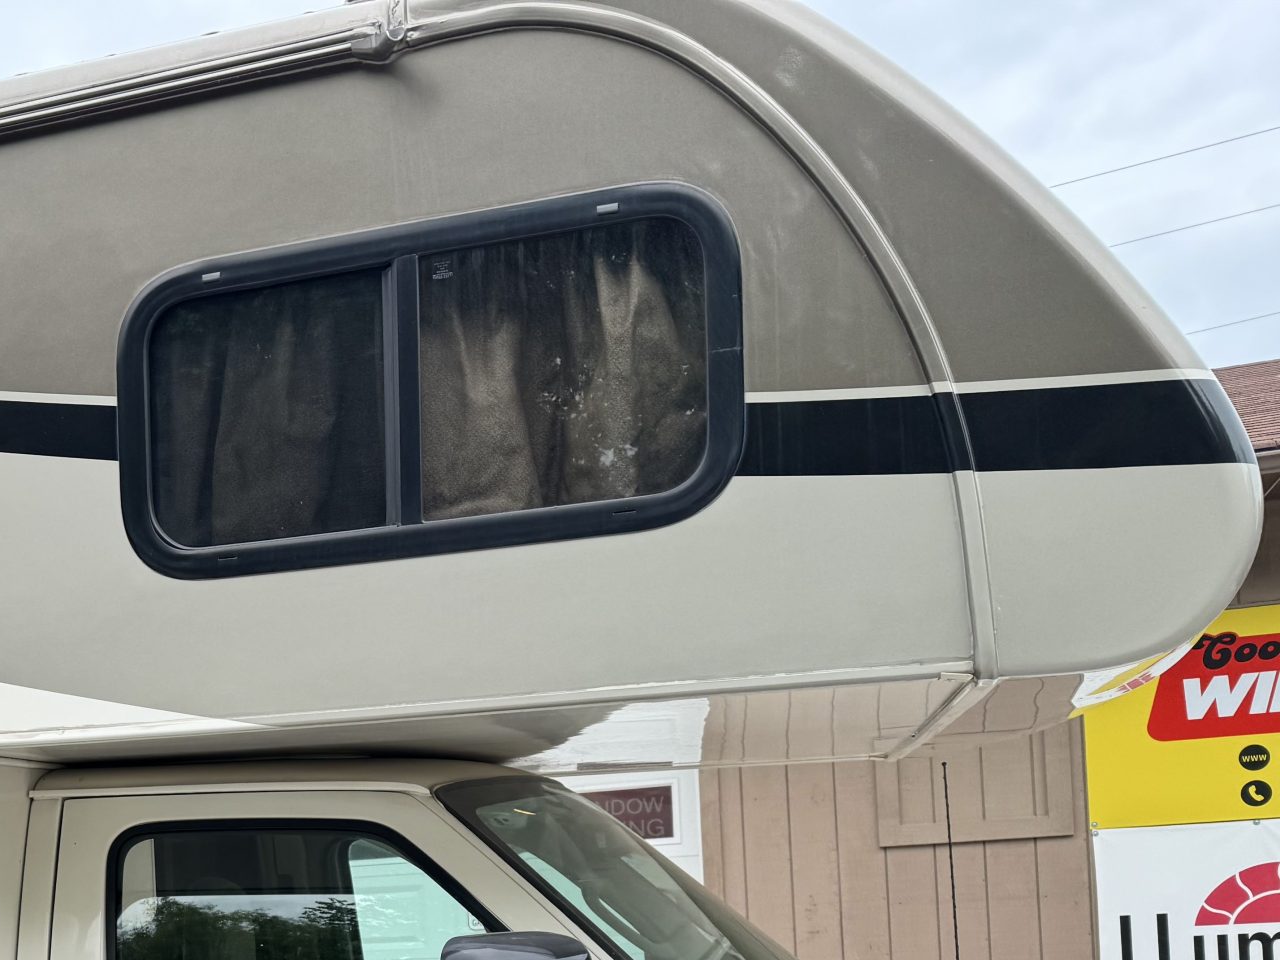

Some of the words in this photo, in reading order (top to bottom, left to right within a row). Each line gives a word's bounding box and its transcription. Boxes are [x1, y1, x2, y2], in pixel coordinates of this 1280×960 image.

[1183, 671, 1280, 720] WI
[595, 796, 664, 816] DOW
[623, 818, 665, 837] NG
